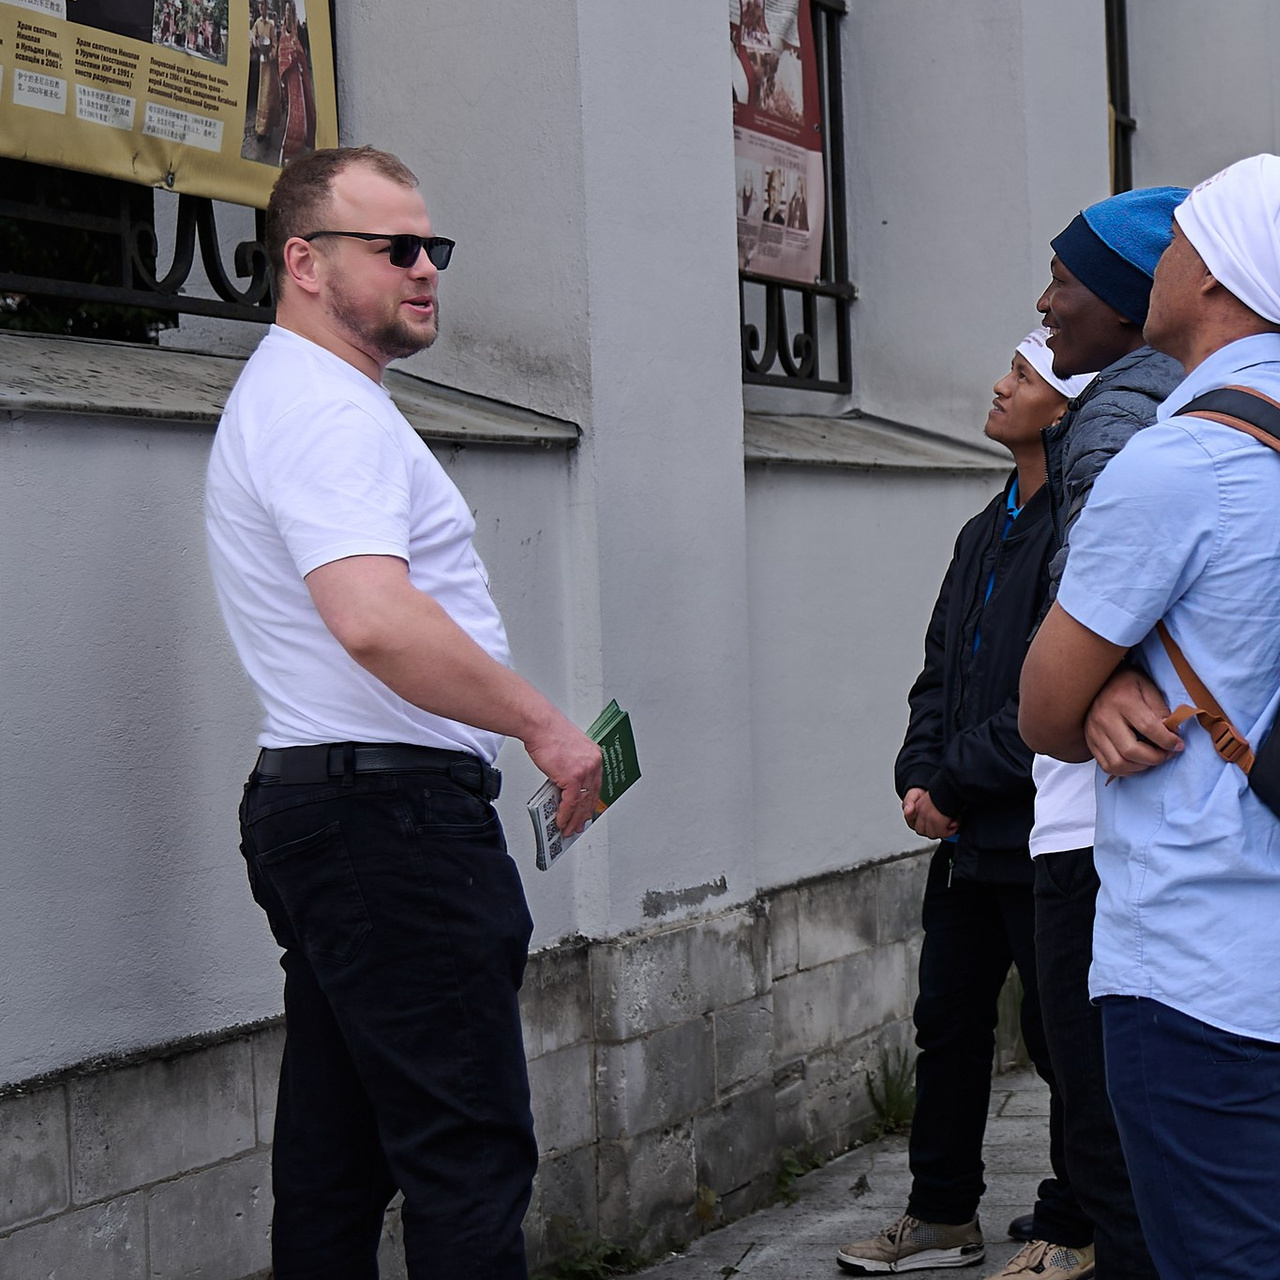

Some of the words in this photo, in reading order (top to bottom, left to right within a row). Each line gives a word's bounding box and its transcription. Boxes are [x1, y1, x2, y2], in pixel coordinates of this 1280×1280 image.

[17, 20, 32, 31] Храм
[76, 37, 91, 47] Храм
[101, 63, 112, 73] КНР
[117, 67, 129, 78] 1991
